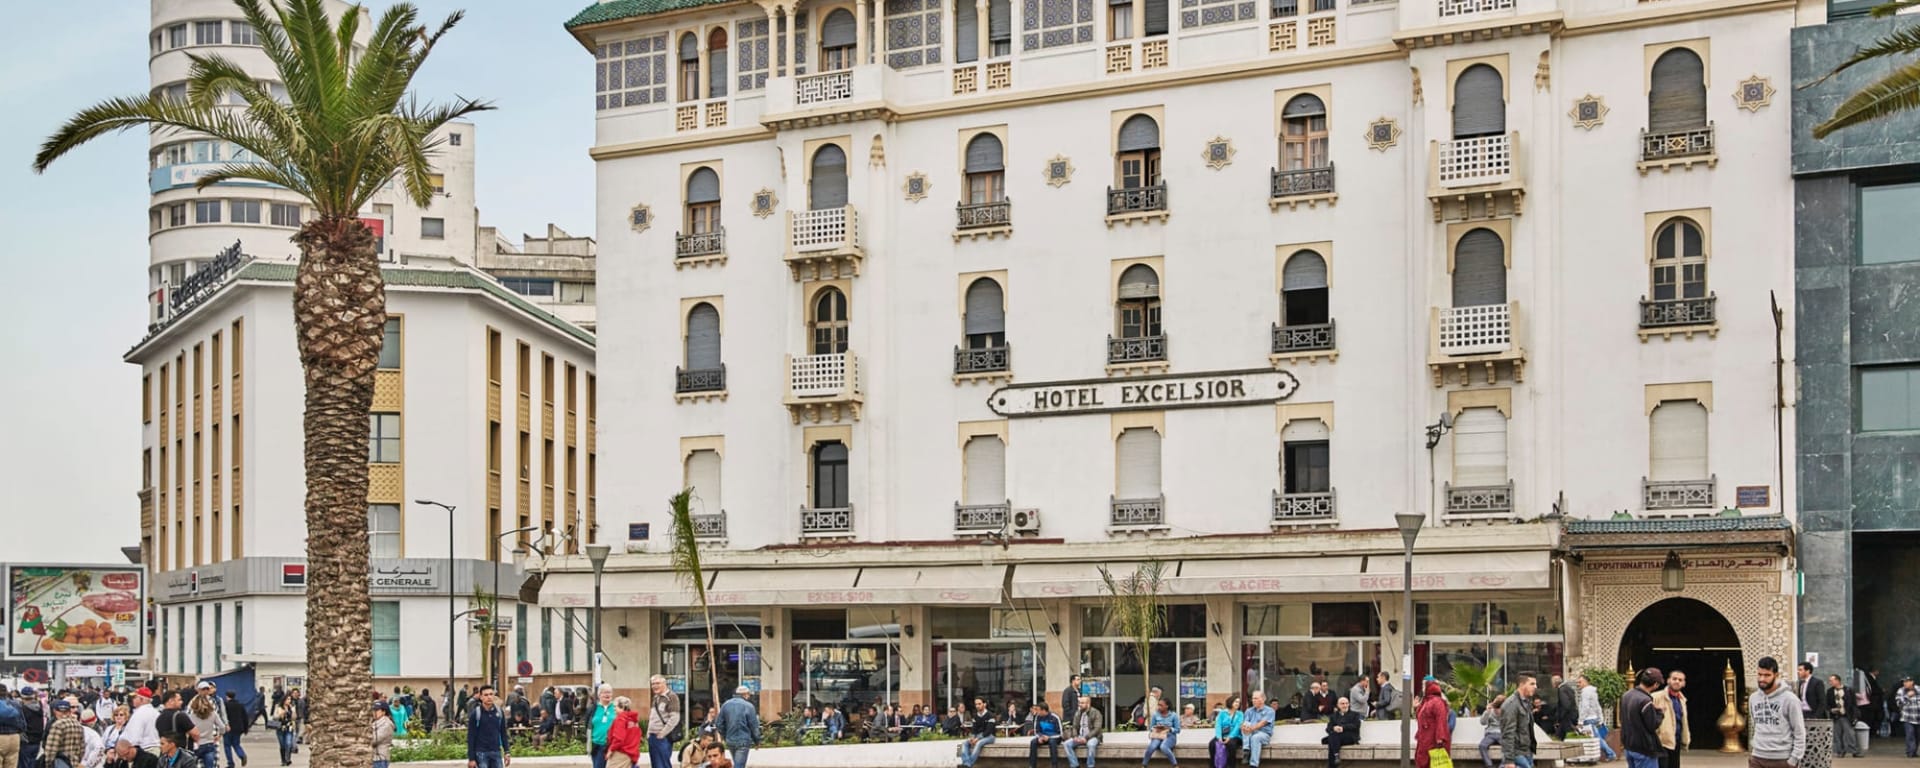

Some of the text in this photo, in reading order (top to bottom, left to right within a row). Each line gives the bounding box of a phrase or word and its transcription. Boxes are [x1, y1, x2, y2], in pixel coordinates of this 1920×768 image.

[1034, 379, 1246, 409] HOTEL EXCELSIOR
[1218, 578, 1281, 592] GLACIER
